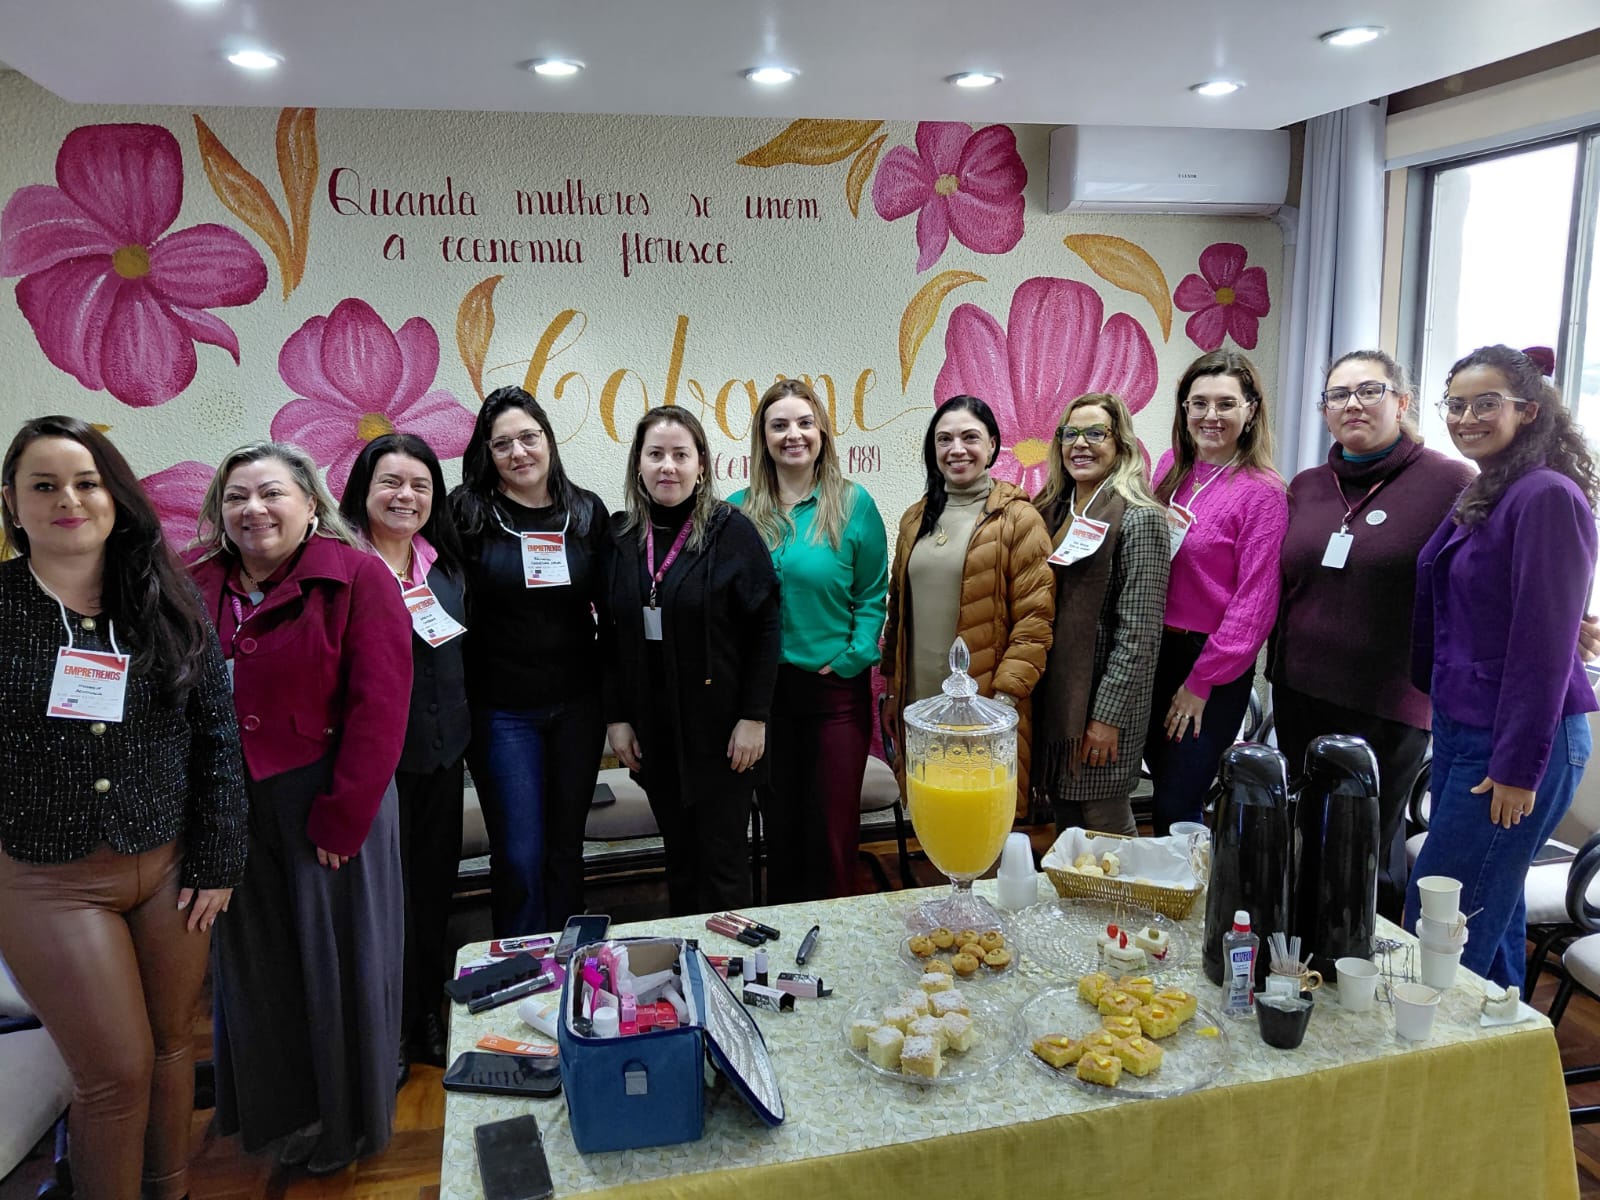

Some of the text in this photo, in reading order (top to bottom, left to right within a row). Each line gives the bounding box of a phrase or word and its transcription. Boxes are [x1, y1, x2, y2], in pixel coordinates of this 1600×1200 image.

[514, 178, 650, 216] mulheres
[685, 193, 713, 218] se
[383, 233, 405, 261] a
[439, 235, 586, 264] economia
[848, 445, 881, 475] 1989
[64, 665, 121, 680] EMPRETRENDS
